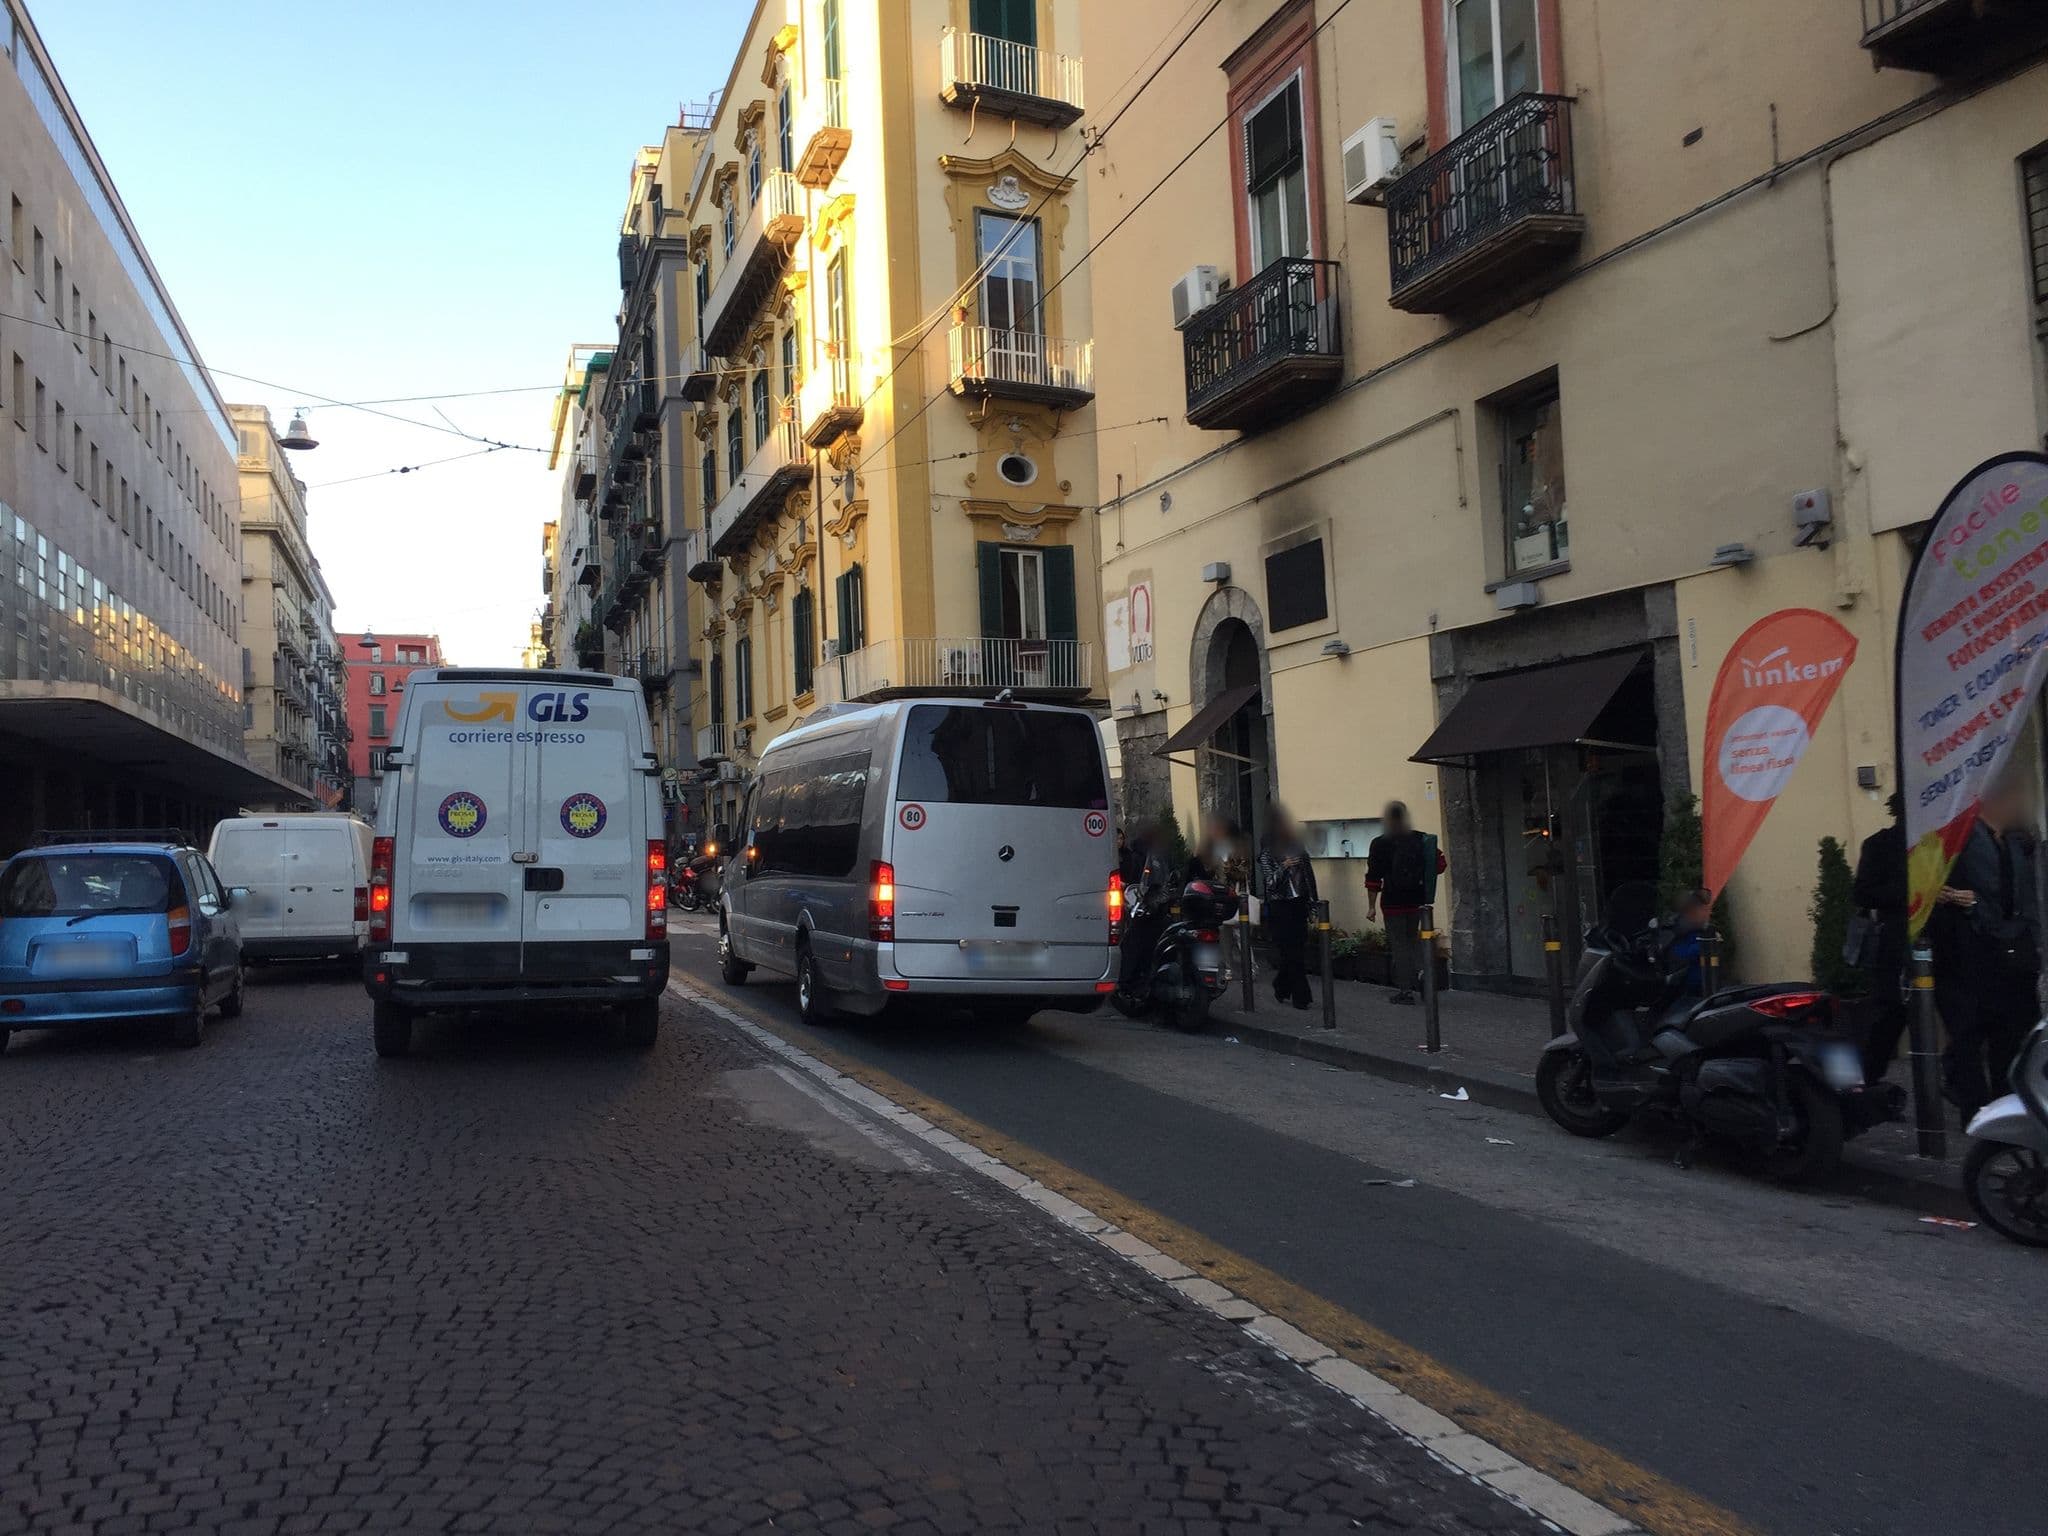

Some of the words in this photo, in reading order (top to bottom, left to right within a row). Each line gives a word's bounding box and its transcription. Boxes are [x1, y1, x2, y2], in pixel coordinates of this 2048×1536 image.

[528, 692, 589, 722] GLS
[449, 729, 513, 743] corriere
[516, 731, 585, 746] espresso
[1731, 746, 1770, 759] senza
[906, 811, 920, 823] 80
[1088, 818, 1104, 830] 100
[427, 855, 501, 863] www.gls-italy.com
